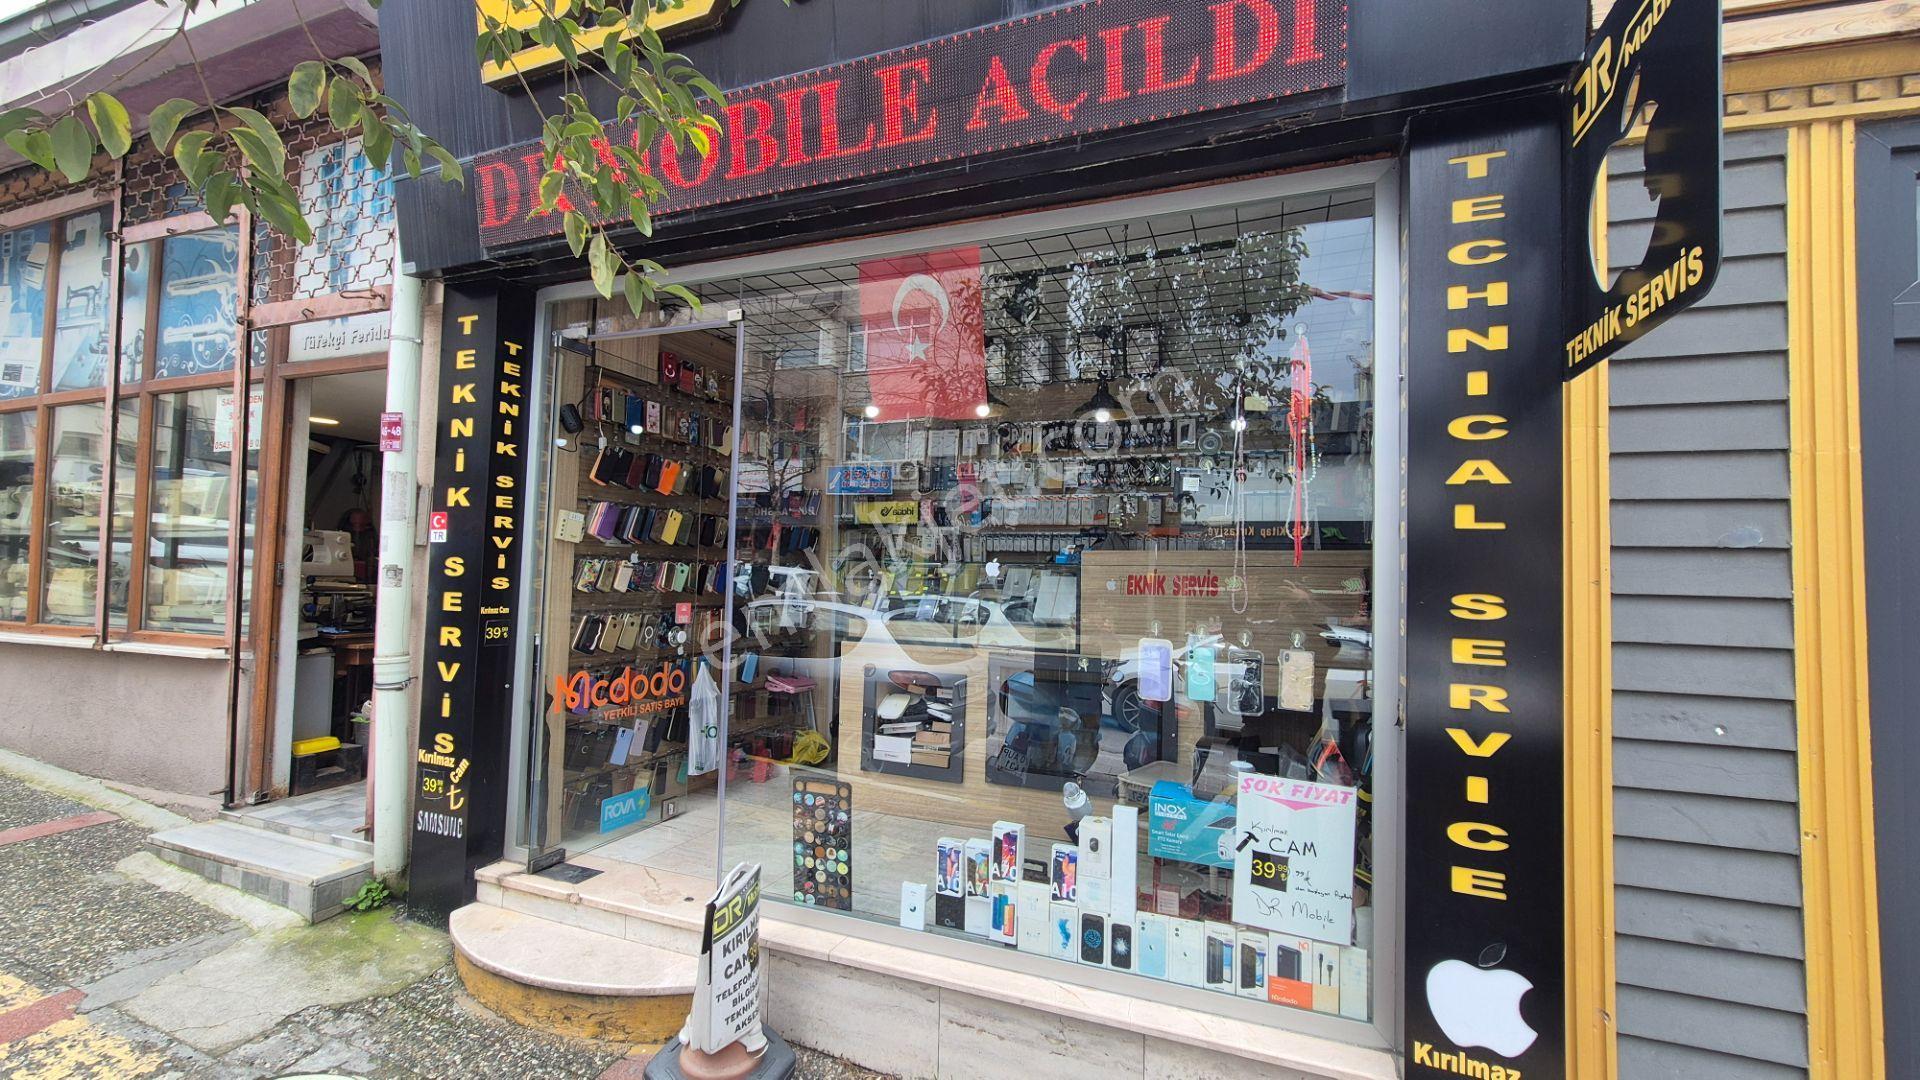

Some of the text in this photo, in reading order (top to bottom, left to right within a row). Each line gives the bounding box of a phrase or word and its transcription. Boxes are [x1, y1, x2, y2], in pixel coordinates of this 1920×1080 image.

[1624, 0, 1673, 68] MOB
[964, 0, 1325, 132] AÇILDI
[1566, 246, 1704, 368] TEKNİK SERVİS
[491, 341, 523, 590] TEKNİK SERVİS
[433, 531, 445, 541] TR
[434, 315, 479, 754] TEKNİK SERVİS
[1446, 151, 1512, 900] TECHNICAL SERVICE
[554, 661, 686, 714] Mcdodo
[603, 704, 639, 721] YETKİLİ
[418, 749, 456, 768] Kırılmaz
[1154, 802, 1187, 815] INOX
[1240, 777, 1353, 805] ŞOK FİYAT
[1268, 837, 1318, 858] CAM
[1414, 1041, 1521, 1080] Kırılmaz
